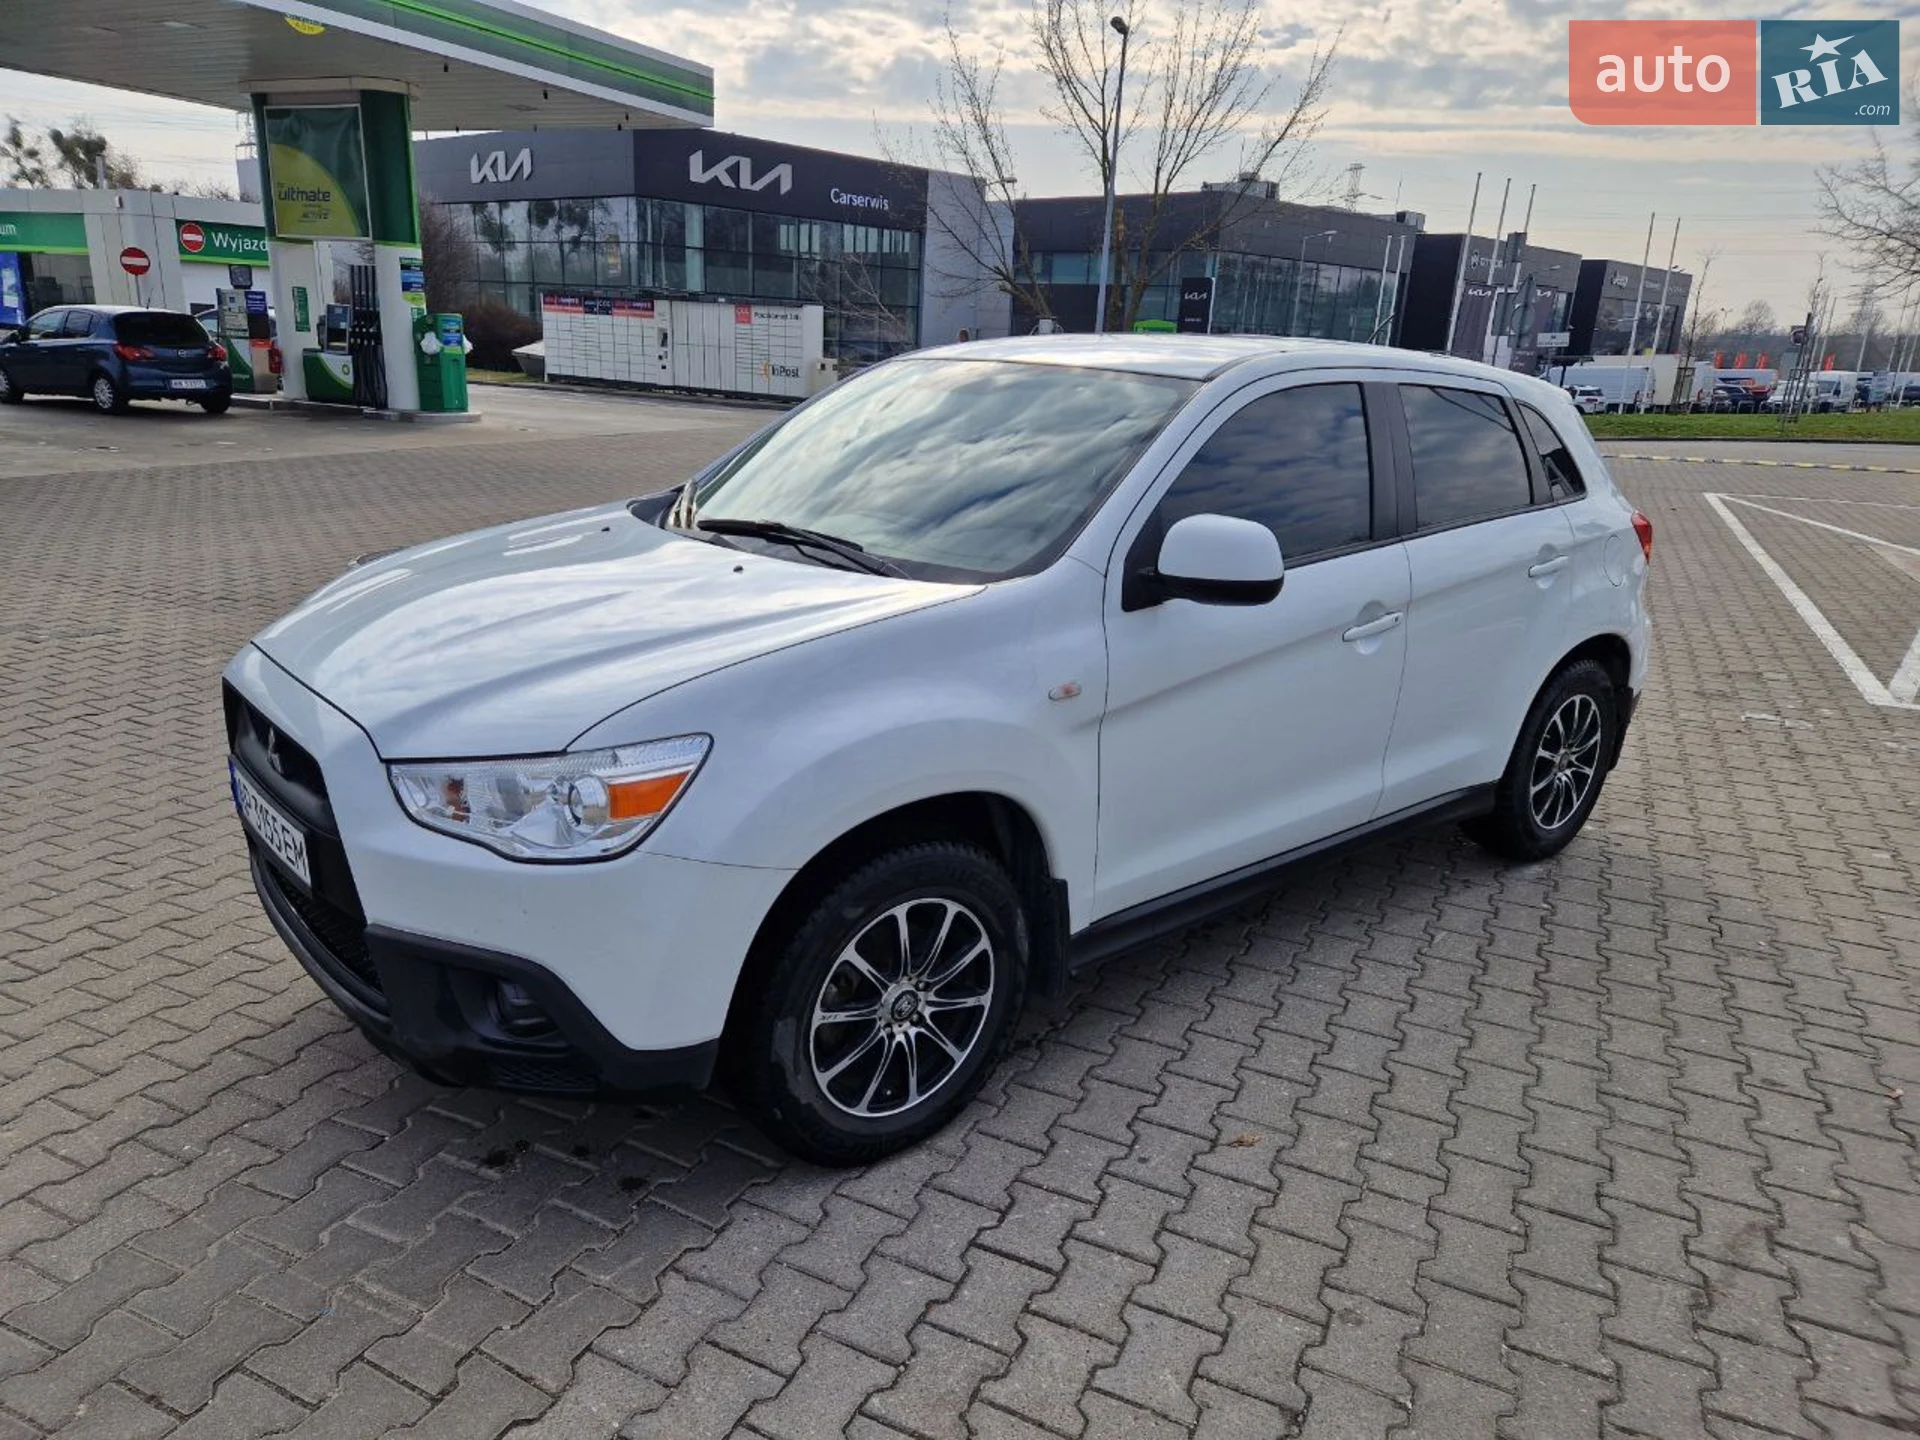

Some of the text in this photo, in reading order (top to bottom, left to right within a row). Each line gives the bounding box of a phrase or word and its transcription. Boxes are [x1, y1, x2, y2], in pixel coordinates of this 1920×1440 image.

[470, 147, 533, 184] KIA
[689, 149, 793, 195] KIA
[278, 187, 331, 202] ultimate
[830, 187, 890, 211] Carserwis
[771, 365, 800, 379] InPost
